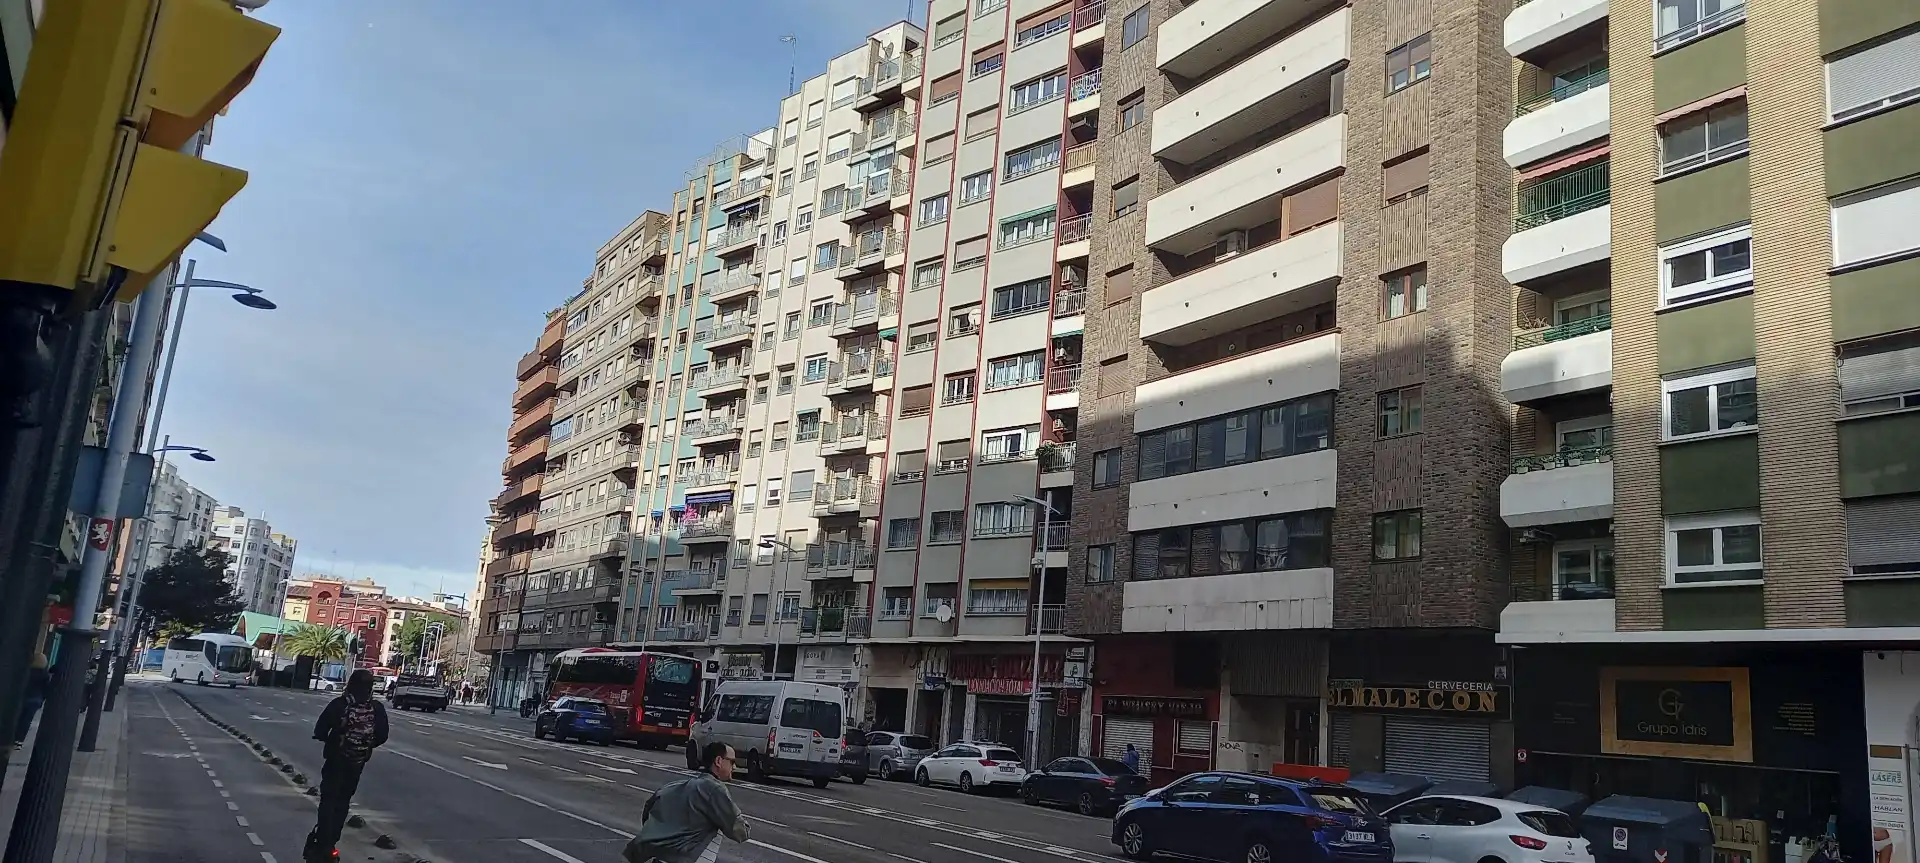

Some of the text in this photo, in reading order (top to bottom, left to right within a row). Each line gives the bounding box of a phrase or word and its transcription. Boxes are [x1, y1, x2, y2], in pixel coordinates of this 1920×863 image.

[1006, 680, 1024, 694] TOTAL
[1428, 680, 1494, 691] CERVECERIA
[1352, 687, 1498, 712] MALECON
[1637, 721, 1679, 736] Grupo
[1874, 805, 1903, 813] HABLAN
